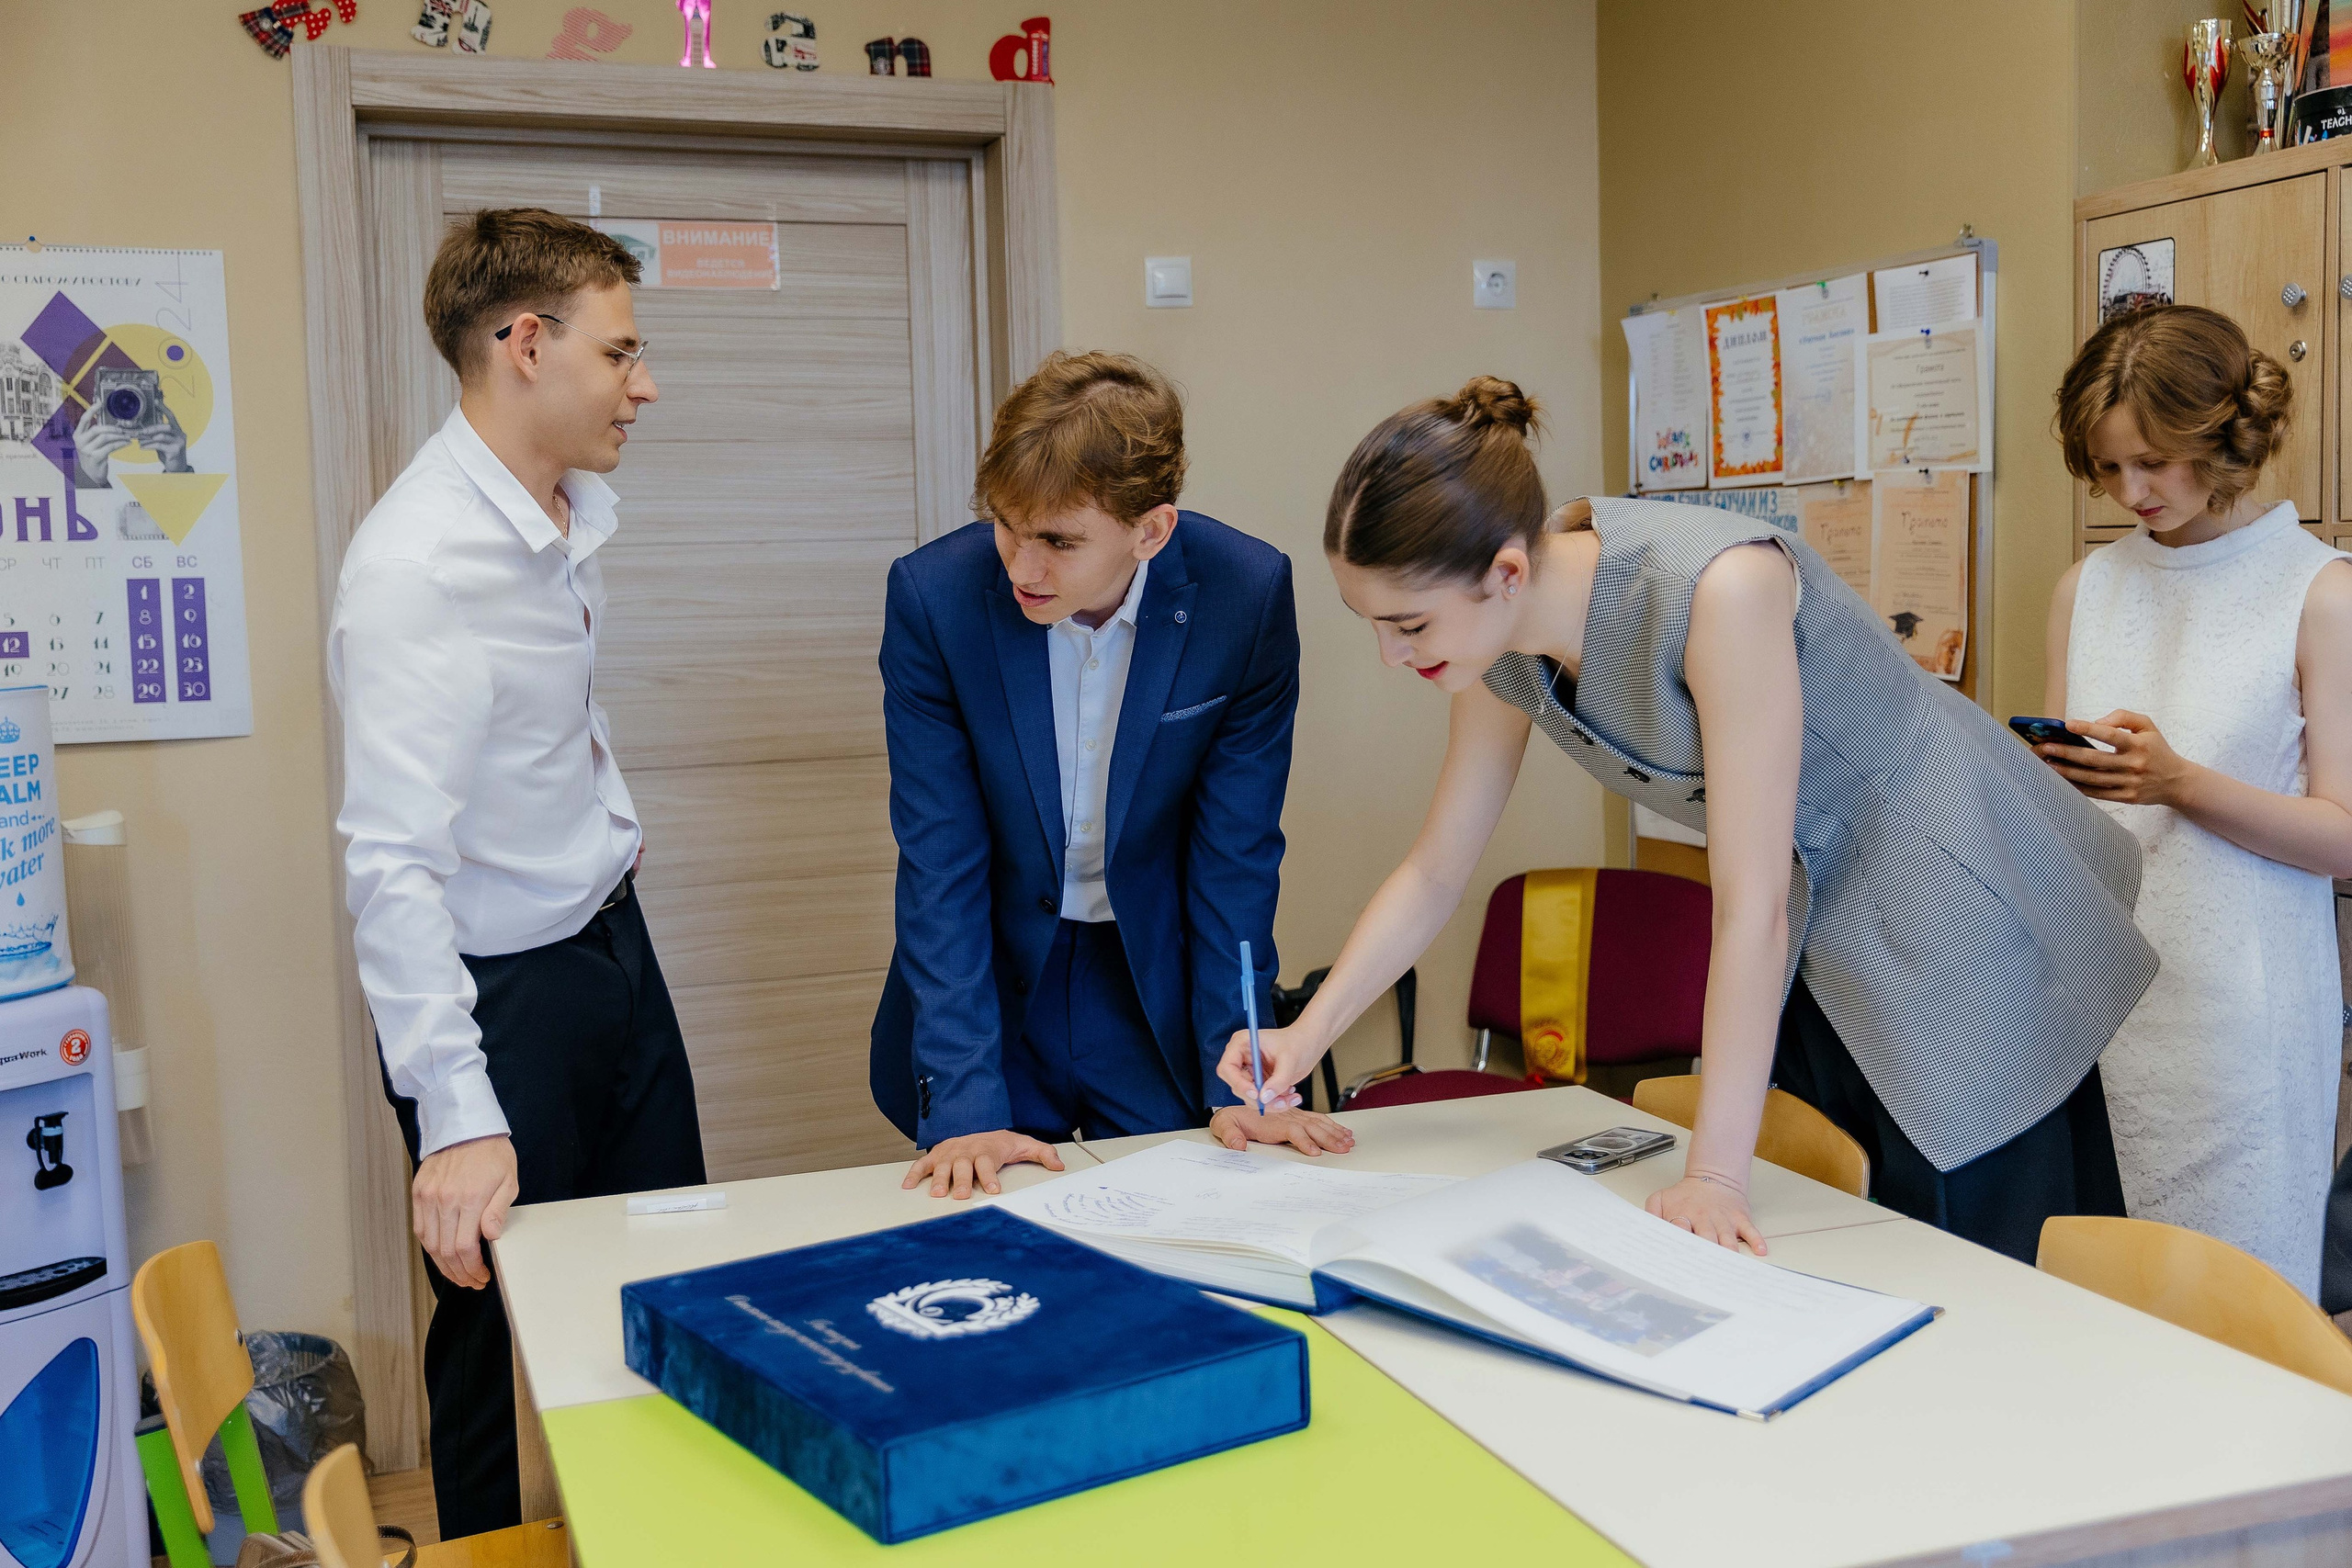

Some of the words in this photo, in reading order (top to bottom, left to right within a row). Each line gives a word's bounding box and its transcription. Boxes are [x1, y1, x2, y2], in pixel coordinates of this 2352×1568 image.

[0, 447, 99, 542] НЬ
[42, 558, 62, 570] ЧТ
[85, 557, 106, 570] ПТ
[131, 556, 154, 569] СБ
[176, 555, 198, 569] ВС
[140, 584, 149, 600] 1
[184, 583, 196, 600] 2
[95, 612, 104, 625] 7
[139, 609, 153, 625] 8
[184, 608, 198, 623] 9
[3, 637, 21, 653] 12
[137, 634, 157, 649] 15
[182, 633, 203, 649] 16
[4, 662, 23, 677] 19
[46, 662, 70, 677] 20
[94, 661, 111, 675] 21
[137, 659, 160, 674] 22
[183, 657, 204, 673] 23
[49, 686, 69, 701] 27
[93, 685, 115, 700] 28
[137, 682, 162, 698] 29
[183, 682, 207, 697] 30
[21, 816, 56, 853] more
[71, 1038, 82, 1055] 2
